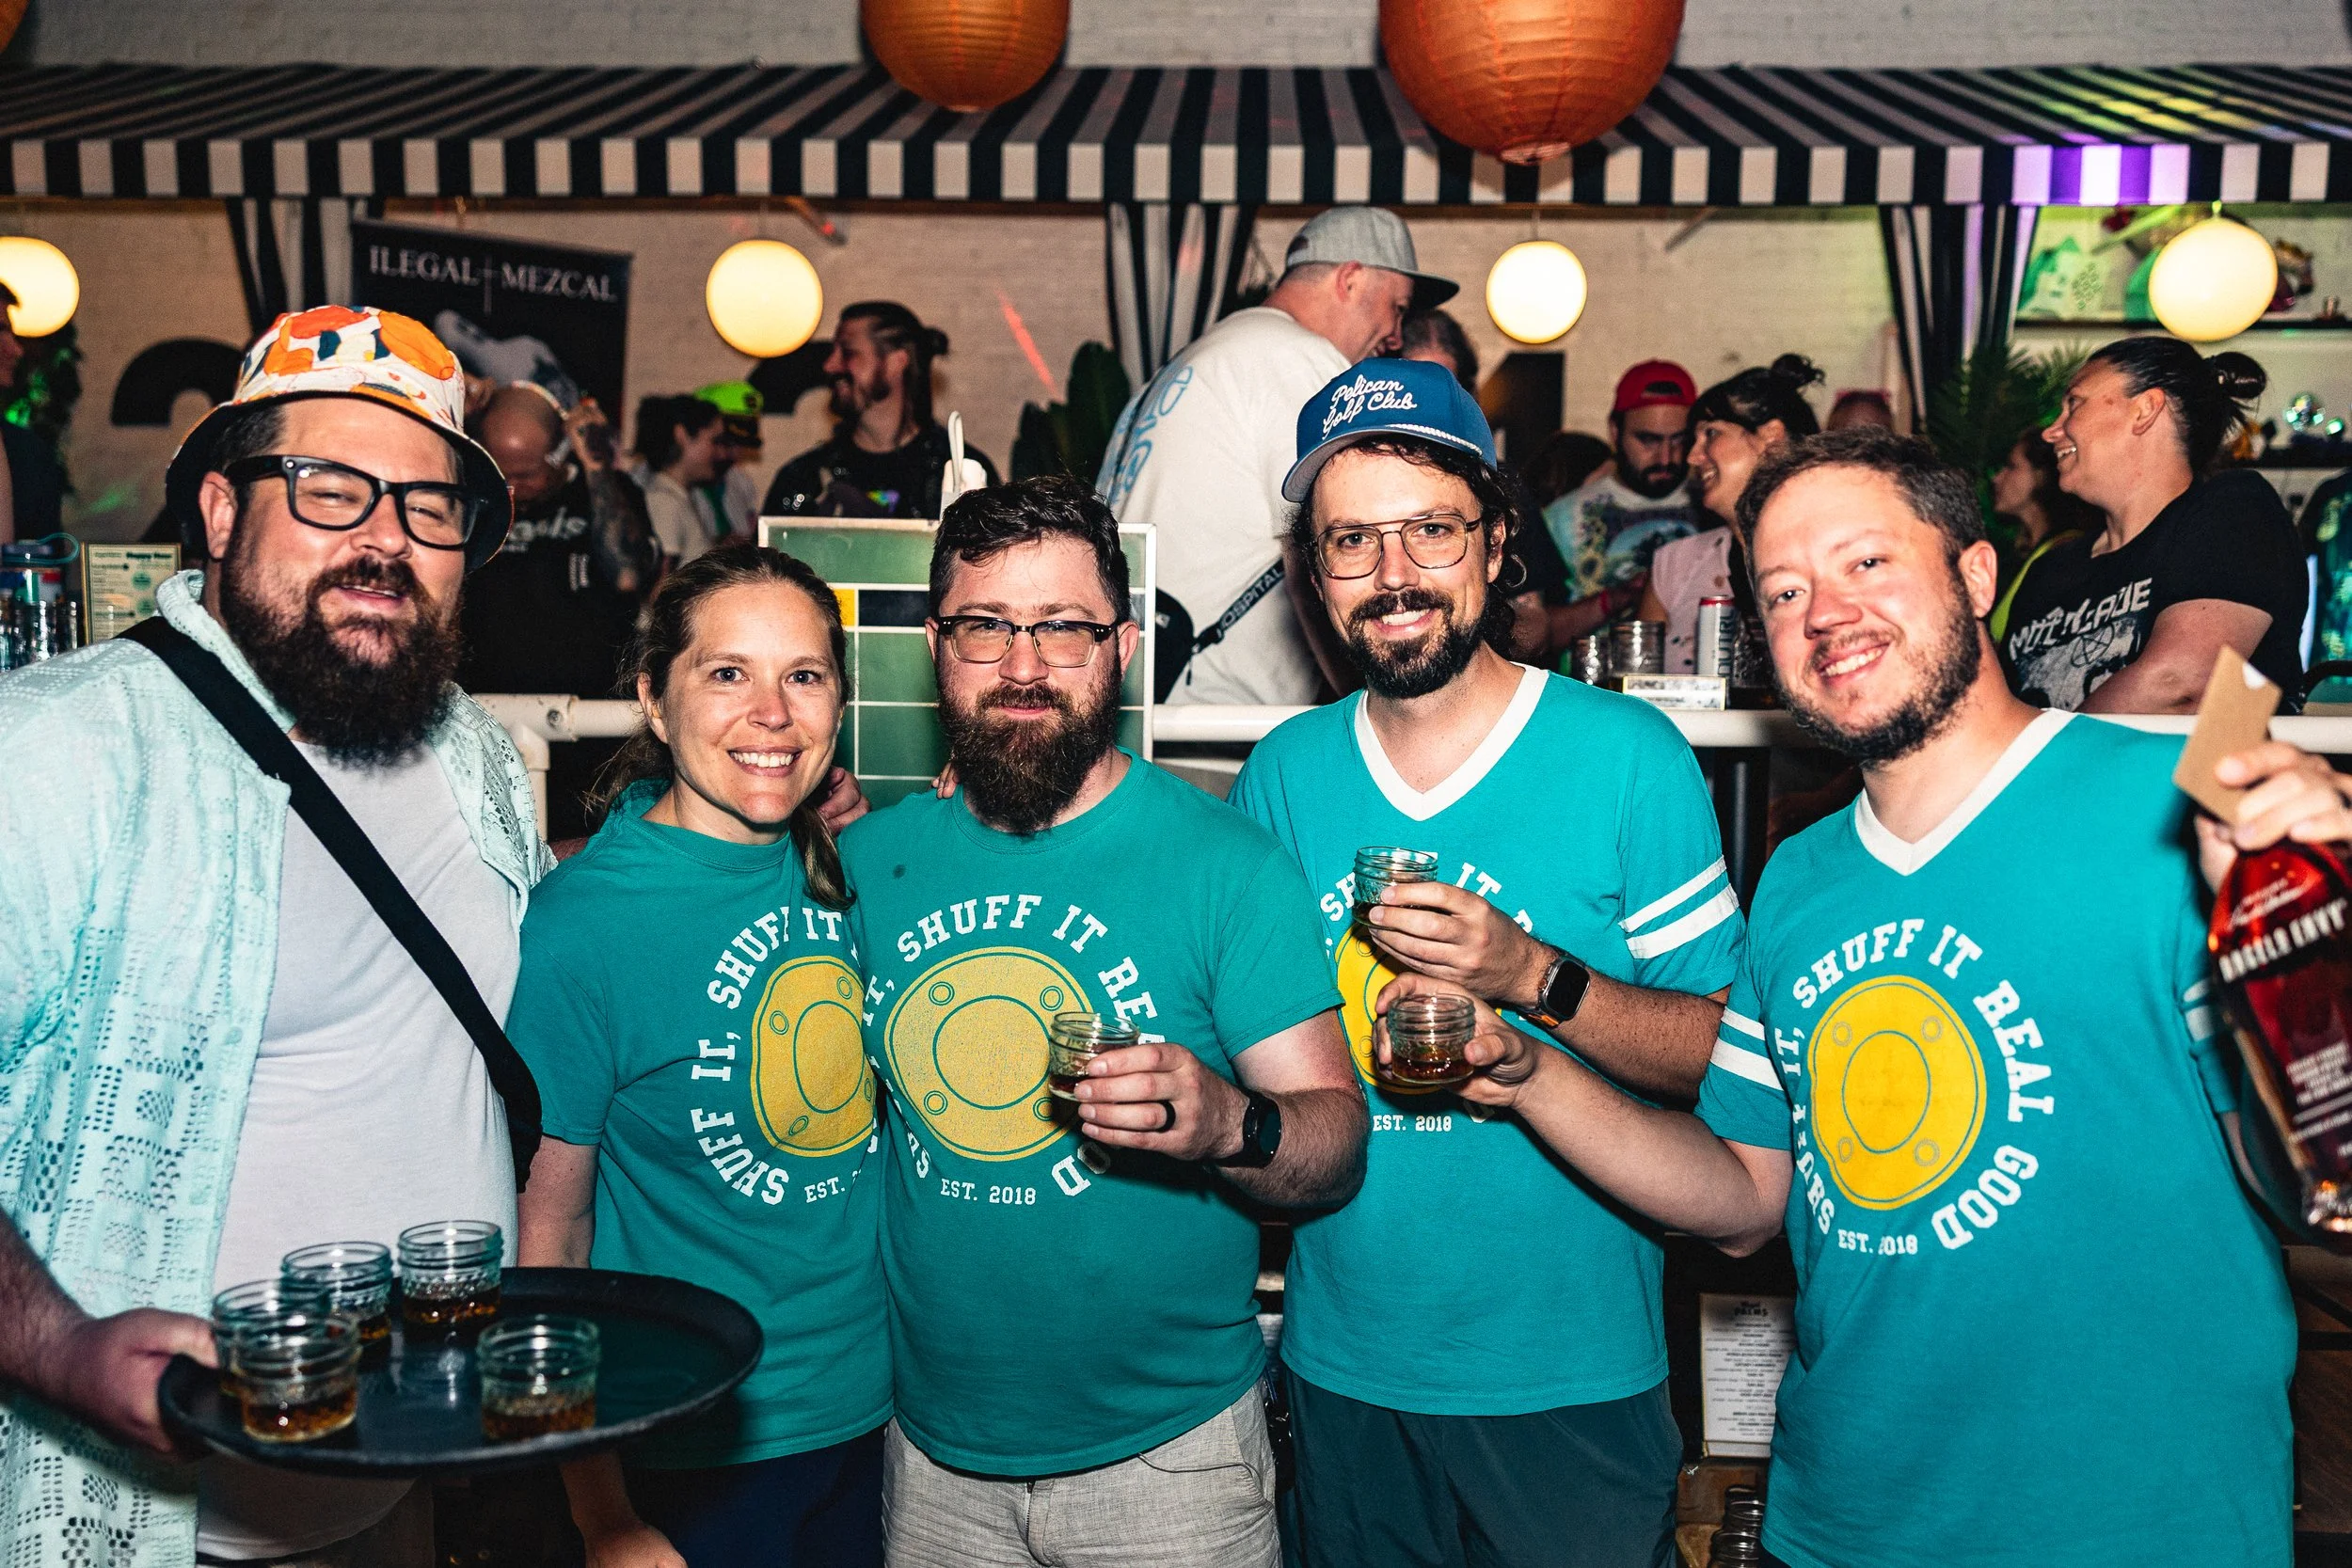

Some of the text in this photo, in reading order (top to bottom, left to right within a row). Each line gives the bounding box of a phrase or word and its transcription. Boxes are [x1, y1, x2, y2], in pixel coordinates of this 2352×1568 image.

[369, 245, 617, 302] ILEGAL MEZCAL
[1322, 391, 1418, 440] Golf Club
[1330, 373, 1404, 410] Pelican
[1219, 567, 1285, 634] OSPITAL
[802, 906, 842, 942] IT
[897, 894, 1042, 962] SHUFF
[1052, 904, 1108, 954] IT
[1792, 918, 1925, 1009] SHUFF
[1929, 924, 1983, 979] IT
[691, 1032, 741, 1082] IT,
[1973, 979, 2055, 1122] REAL
[1372, 1115, 1452, 1132] EST. 2018
[691, 1108, 789, 1206] SHUFF
[804, 1177, 846, 1203] EST.
[941, 1178, 1037, 1206] EST. 2018
[1931, 1145, 2040, 1250] GOOD
[1838, 1229, 1873, 1254] EST.
